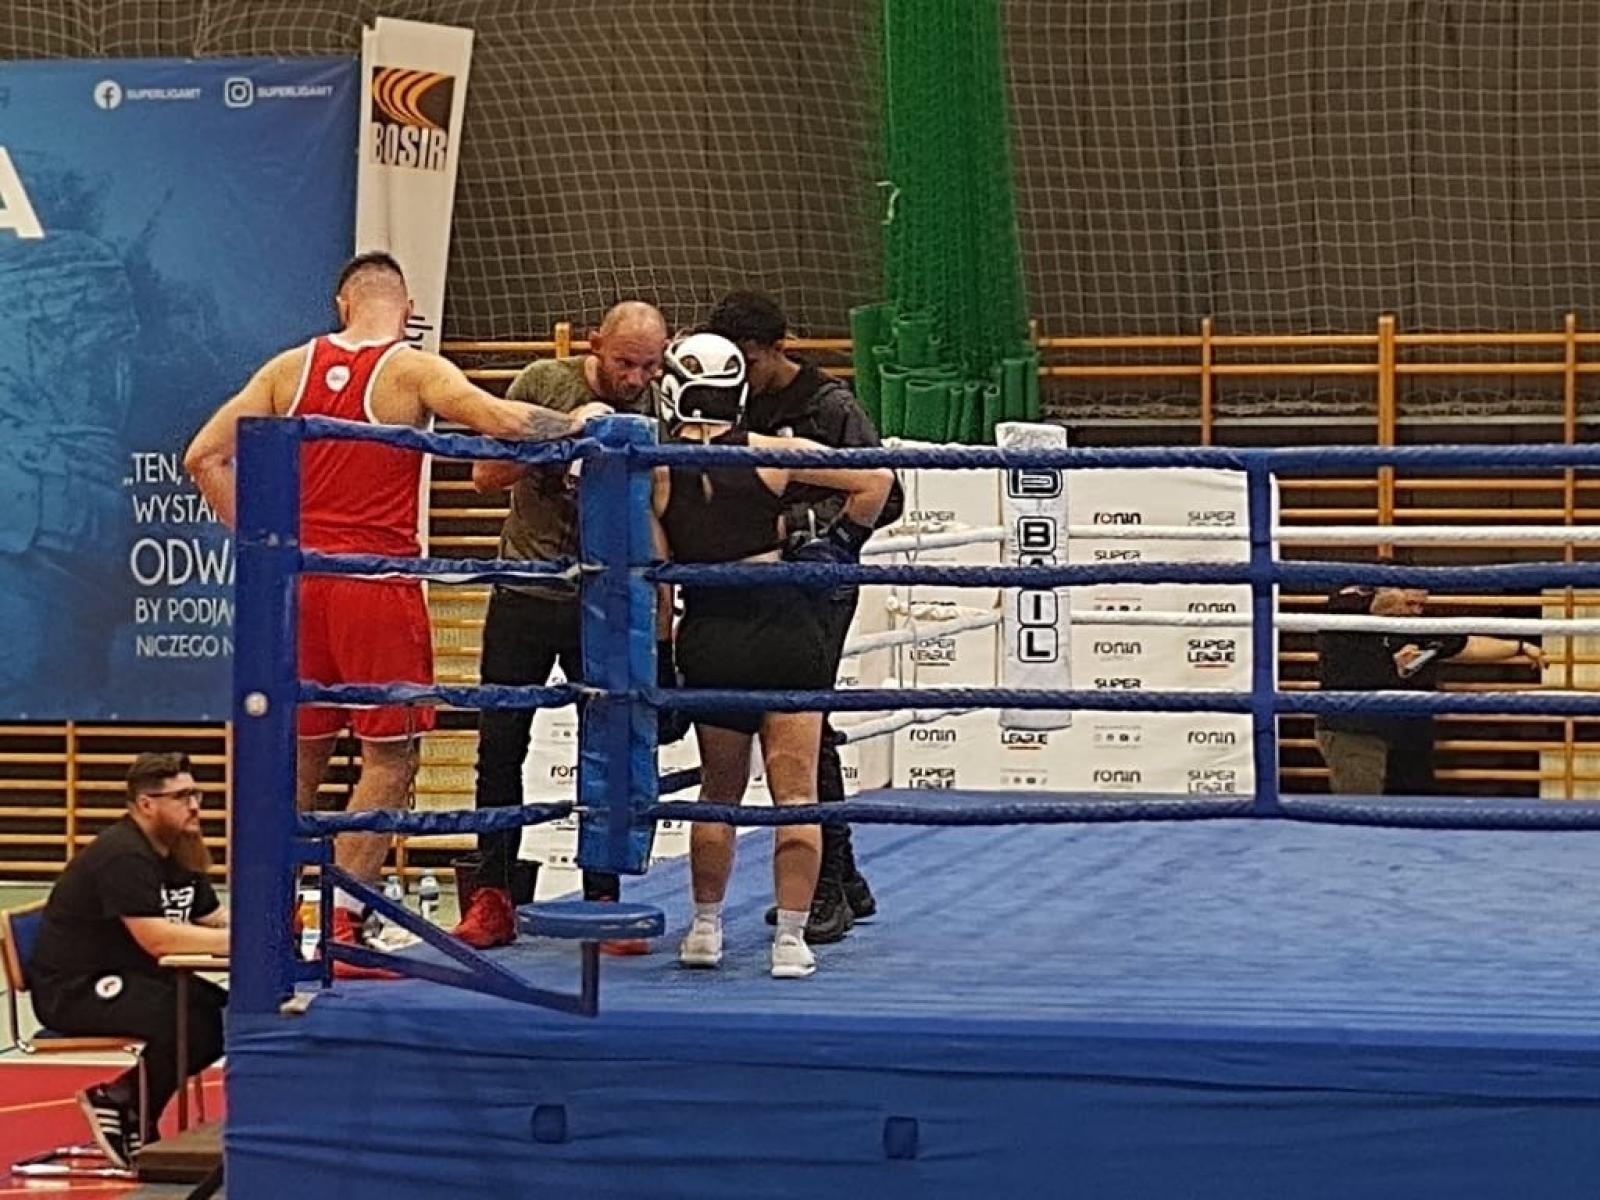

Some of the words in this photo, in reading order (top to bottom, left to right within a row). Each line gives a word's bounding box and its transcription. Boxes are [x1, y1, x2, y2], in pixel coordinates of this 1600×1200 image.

[370, 122, 447, 170] BOSIR
[136, 598, 161, 623] BY
[136, 635, 219, 657] NICZEGO
[1188, 639, 1236, 650] SUPER
